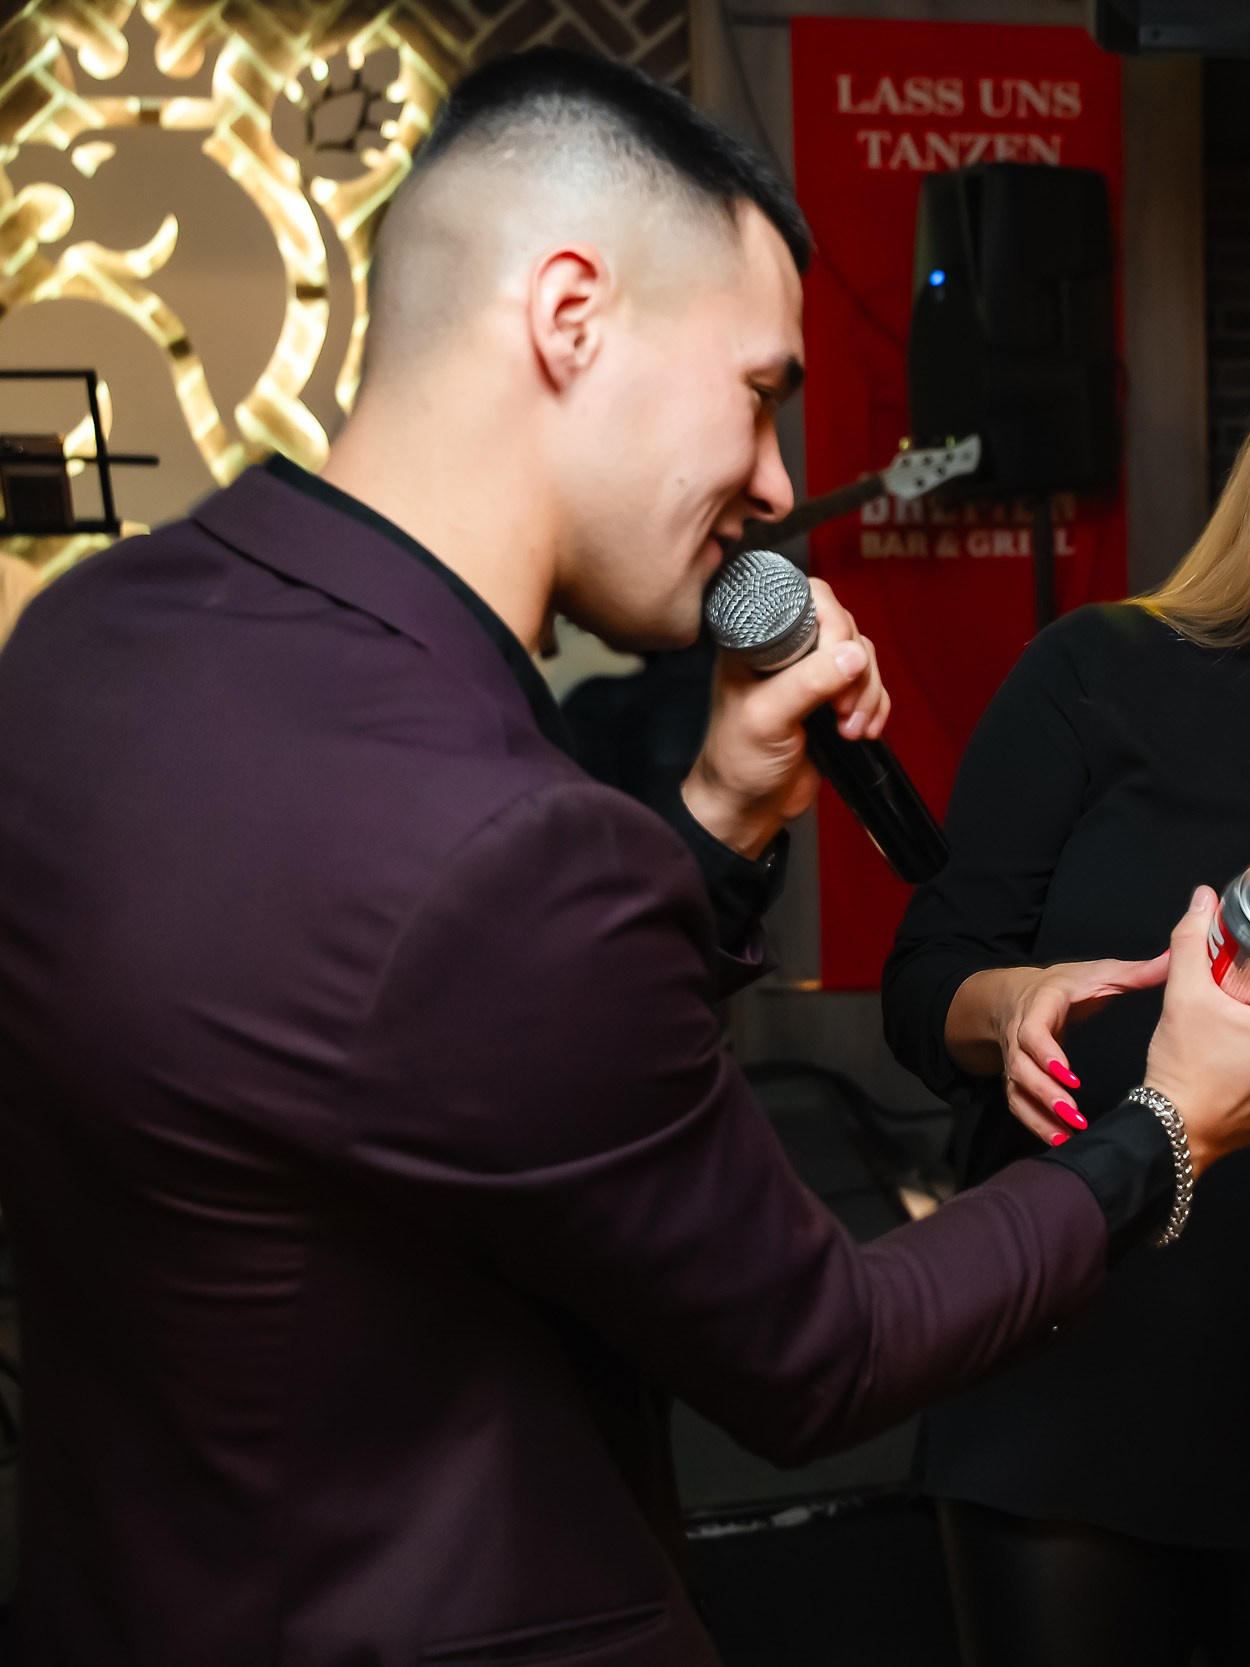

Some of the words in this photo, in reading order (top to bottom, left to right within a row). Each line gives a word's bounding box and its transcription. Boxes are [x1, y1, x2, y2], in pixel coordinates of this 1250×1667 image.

[837, 74, 964, 117] LASS
[979, 78, 1082, 119] UNS
[857, 129, 1062, 170] TANZEN
[860, 531, 928, 559] BAR
[935, 532, 961, 559] &
[966, 529, 1076, 558] GRIL
